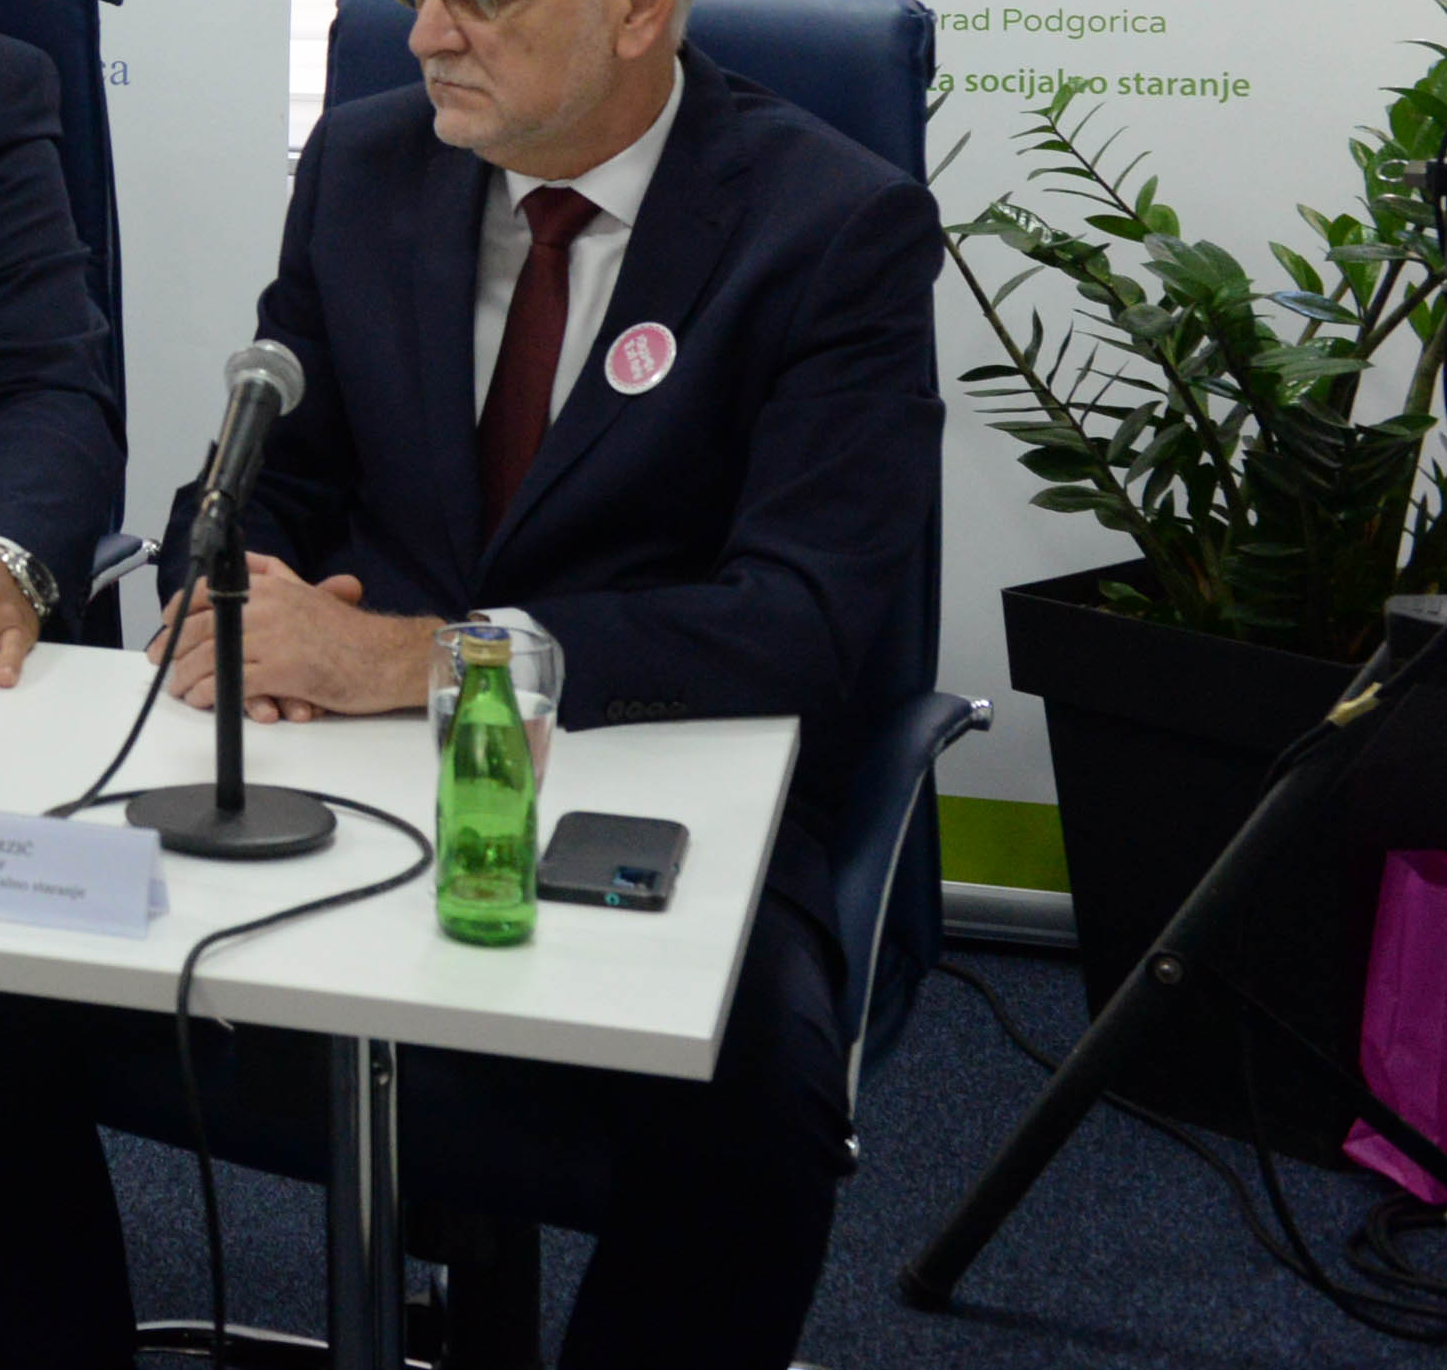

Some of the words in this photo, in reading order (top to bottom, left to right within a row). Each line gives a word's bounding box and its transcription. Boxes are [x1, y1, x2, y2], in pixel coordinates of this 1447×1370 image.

[940, 7, 990, 31] rad
[1002, 7, 1167, 40] Podgorica
[1117, 70, 1251, 104] staranje
